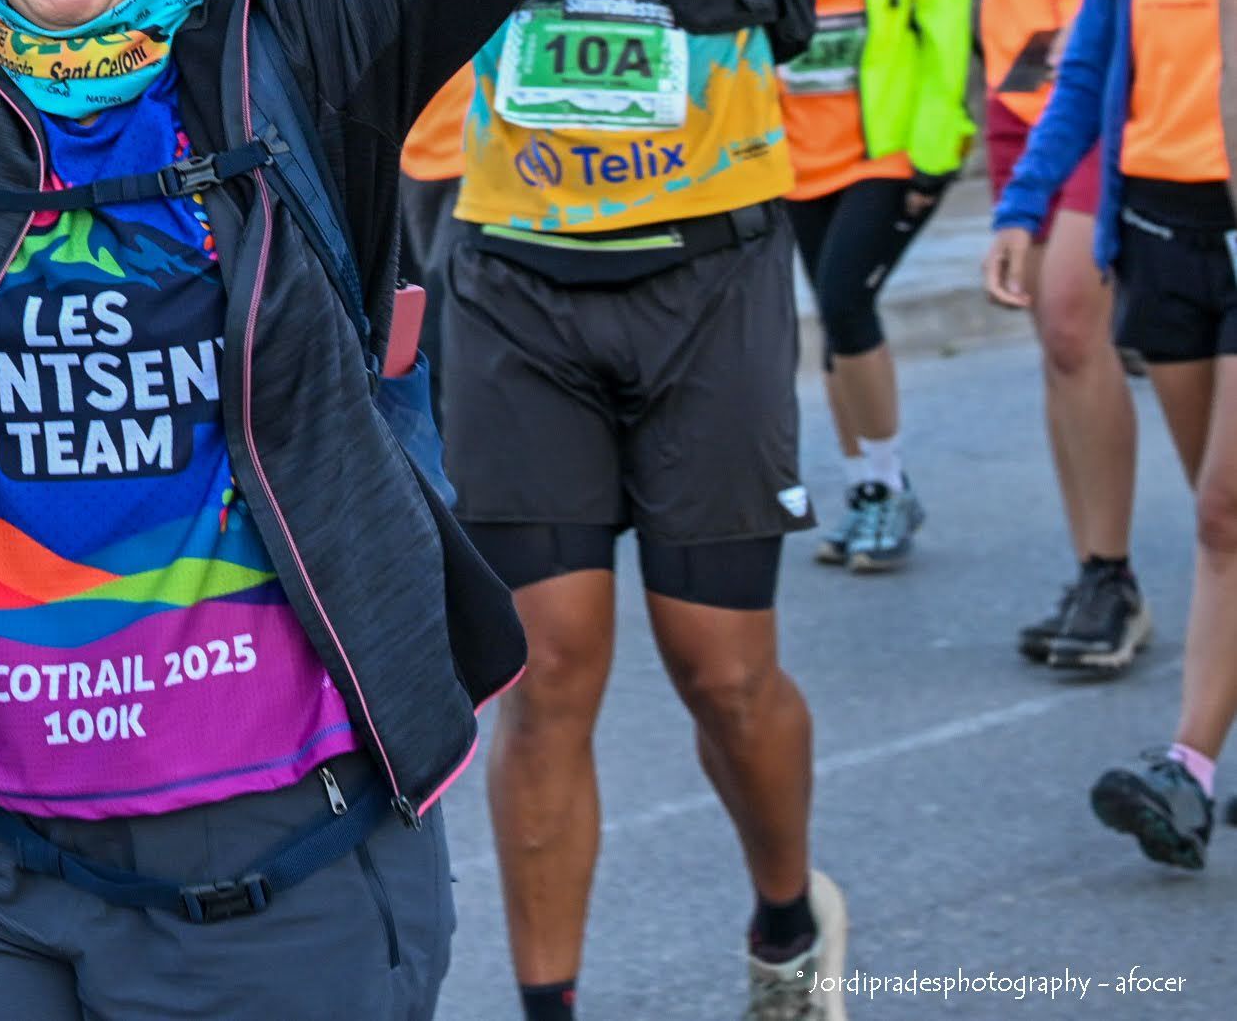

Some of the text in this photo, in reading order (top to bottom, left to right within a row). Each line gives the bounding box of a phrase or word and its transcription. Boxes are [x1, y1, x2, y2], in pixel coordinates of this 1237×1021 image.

[545, 33, 653, 78] 10A
[571, 139, 685, 186] Telix
[22, 290, 133, 347] LES
[6, 415, 173, 476] TEAM
[163, 633, 257, 687] 2025
[44, 703, 147, 745] 100K
